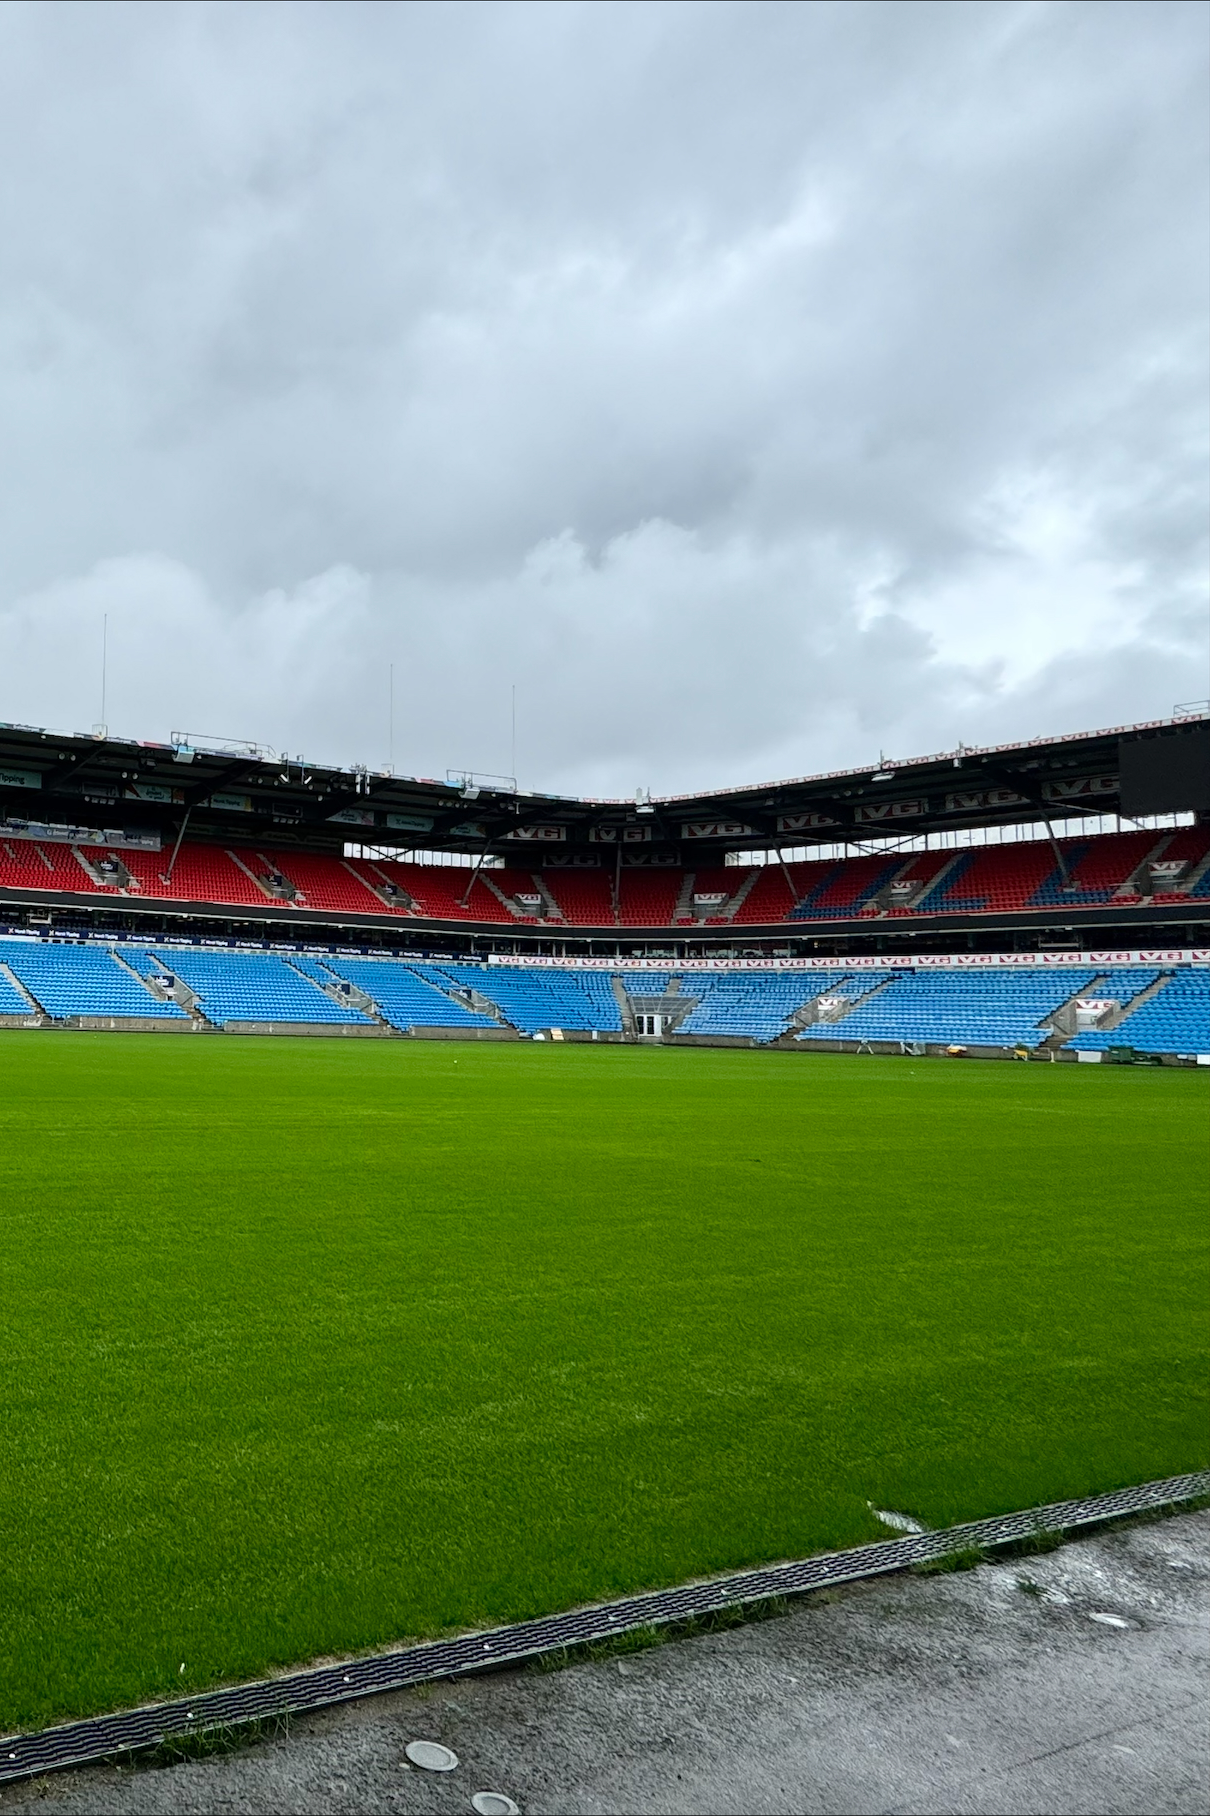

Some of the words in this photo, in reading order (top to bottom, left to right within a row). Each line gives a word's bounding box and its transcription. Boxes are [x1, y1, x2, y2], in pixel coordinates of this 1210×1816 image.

[1171, 714, 1201, 724] VG
[1133, 720, 1162, 730] VG
[1096, 726, 1124, 736] VG
[965, 748, 989, 756] VG
[1052, 776, 1120, 797] VG
[955, 790, 1018, 808] VG
[862, 802, 920, 820] VG
[783, 814, 834, 830] VG
[515, 827, 560, 839] VG
[597, 828, 645, 840] VG
[688, 823, 744, 836] VG
[549, 854, 598, 864] VG
[626, 854, 675, 864] VG
[1153, 862, 1186, 870] VG
[1090, 953, 1131, 961] VG
[1140, 952, 1182, 960] VG
[1076, 1000, 1113, 1009] VG
